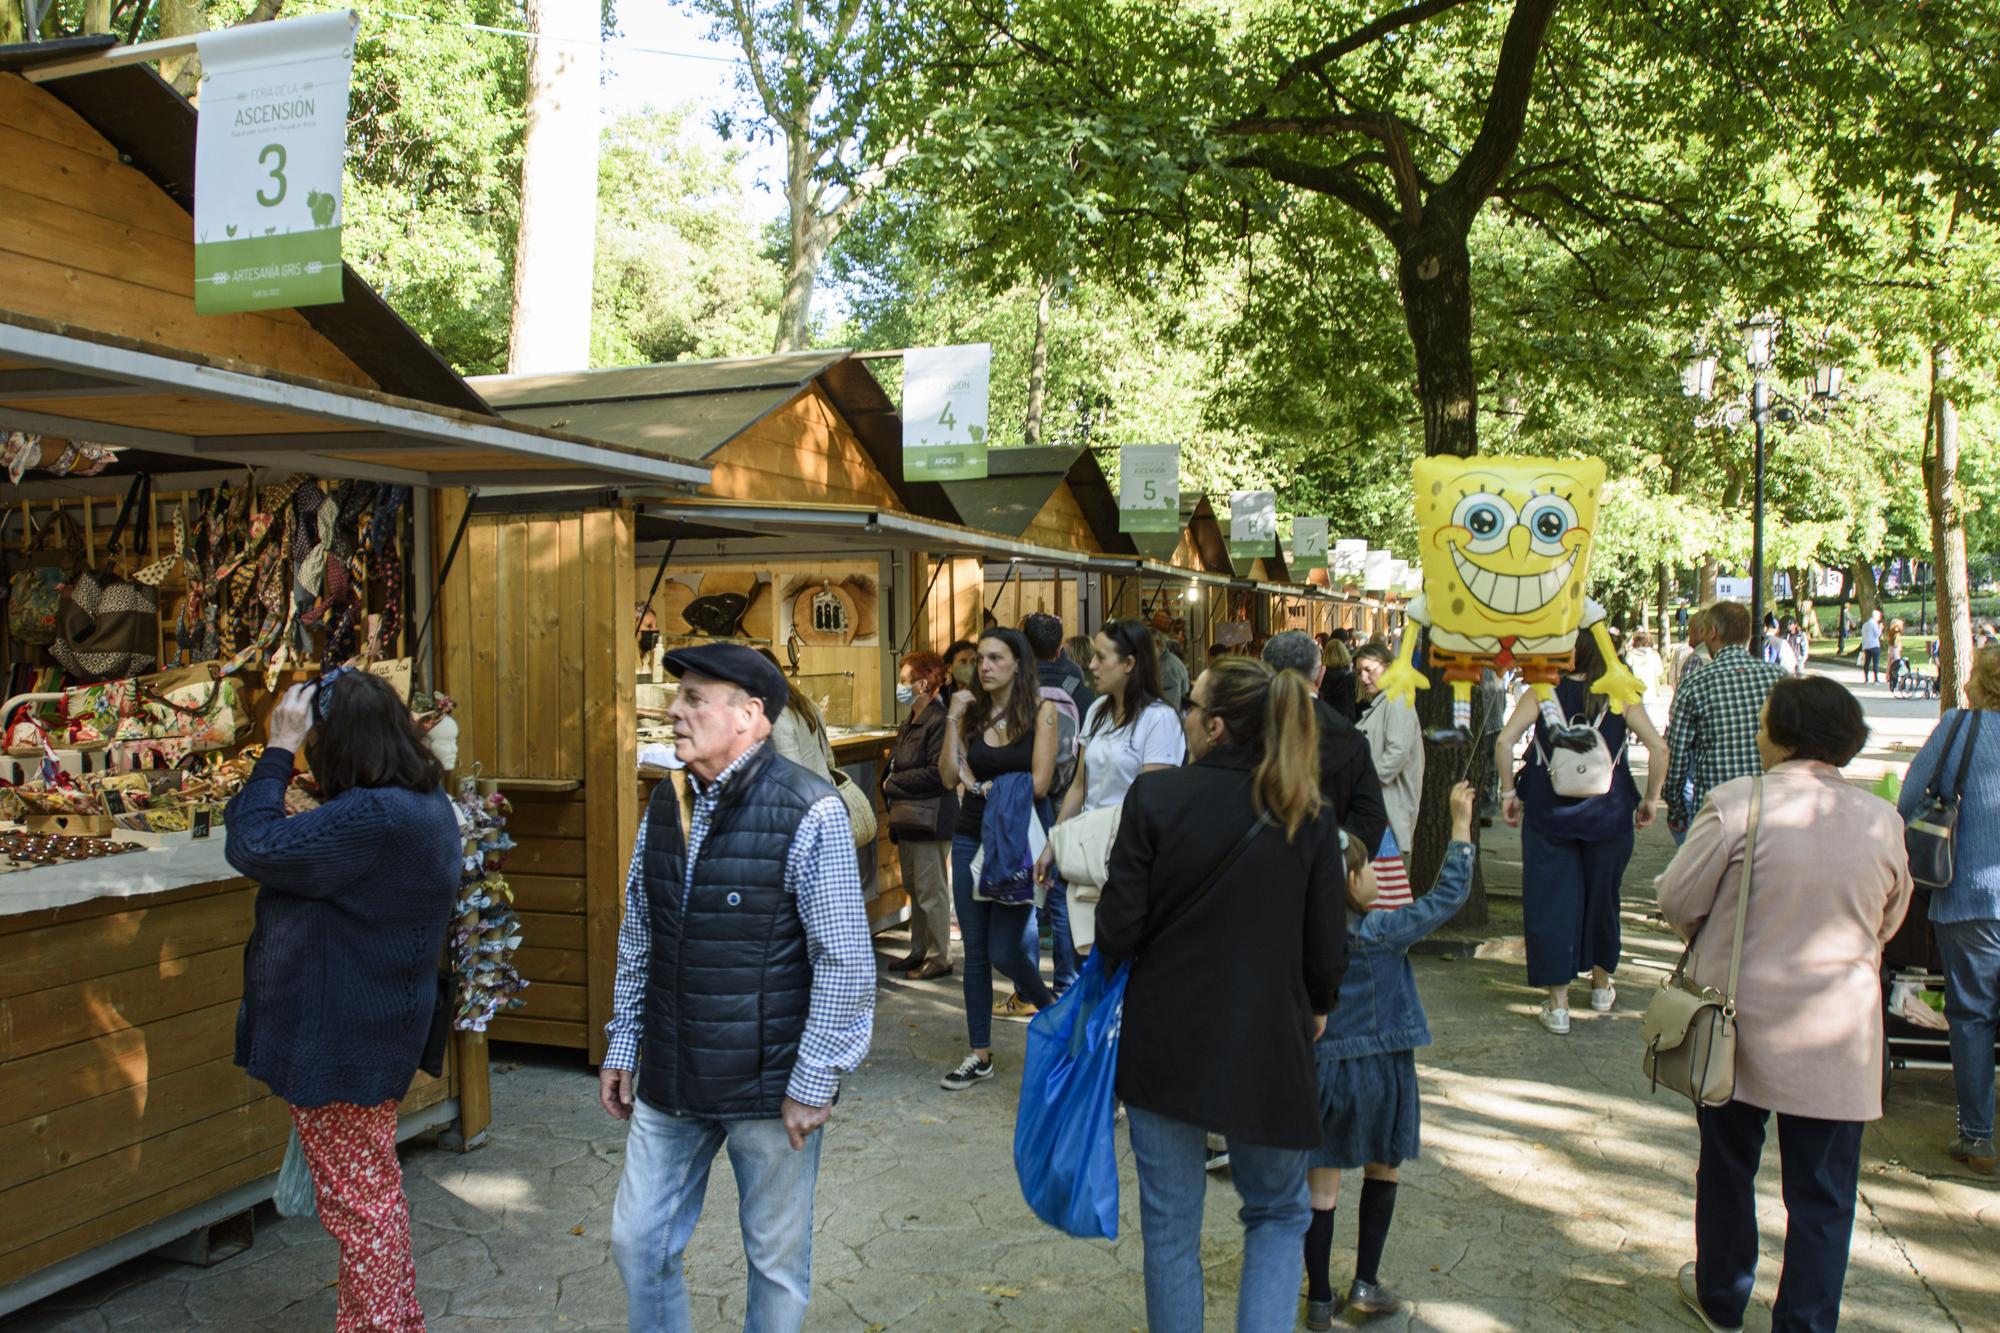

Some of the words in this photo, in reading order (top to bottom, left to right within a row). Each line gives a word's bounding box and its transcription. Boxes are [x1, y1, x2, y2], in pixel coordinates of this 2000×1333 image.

[234, 95, 315, 127] ASCENSIÓN
[256, 143, 287, 208] 3
[232, 262, 280, 282] ARTESANÍA
[281, 262, 302, 278] GRIS
[938, 401, 957, 431] 4
[1143, 480, 1156, 501] 5
[1306, 538, 1315, 551] 7
